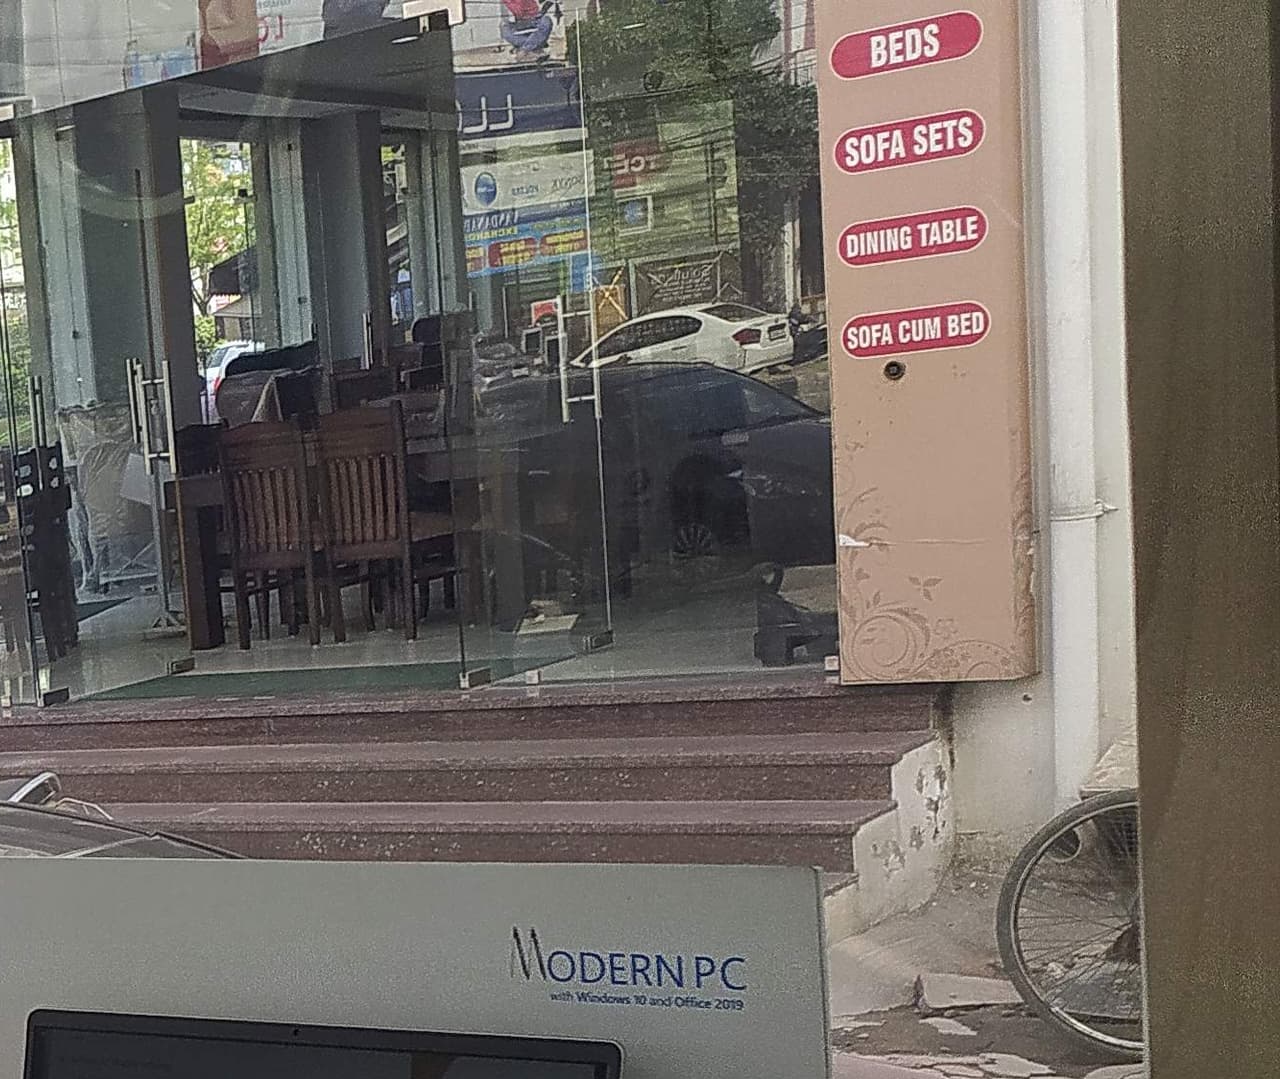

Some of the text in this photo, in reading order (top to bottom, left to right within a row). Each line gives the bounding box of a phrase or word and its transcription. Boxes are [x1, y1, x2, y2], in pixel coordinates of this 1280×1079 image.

[870, 24, 940, 67] BEDS
[845, 117, 974, 168] SOFA SETS
[846, 215, 978, 259] DINING TABLE
[847, 312, 984, 350] SOFA CUM BED
[510, 926, 748, 991] MODERN PC
[551, 991, 744, 1011] with Windows 10 and Office 2019
